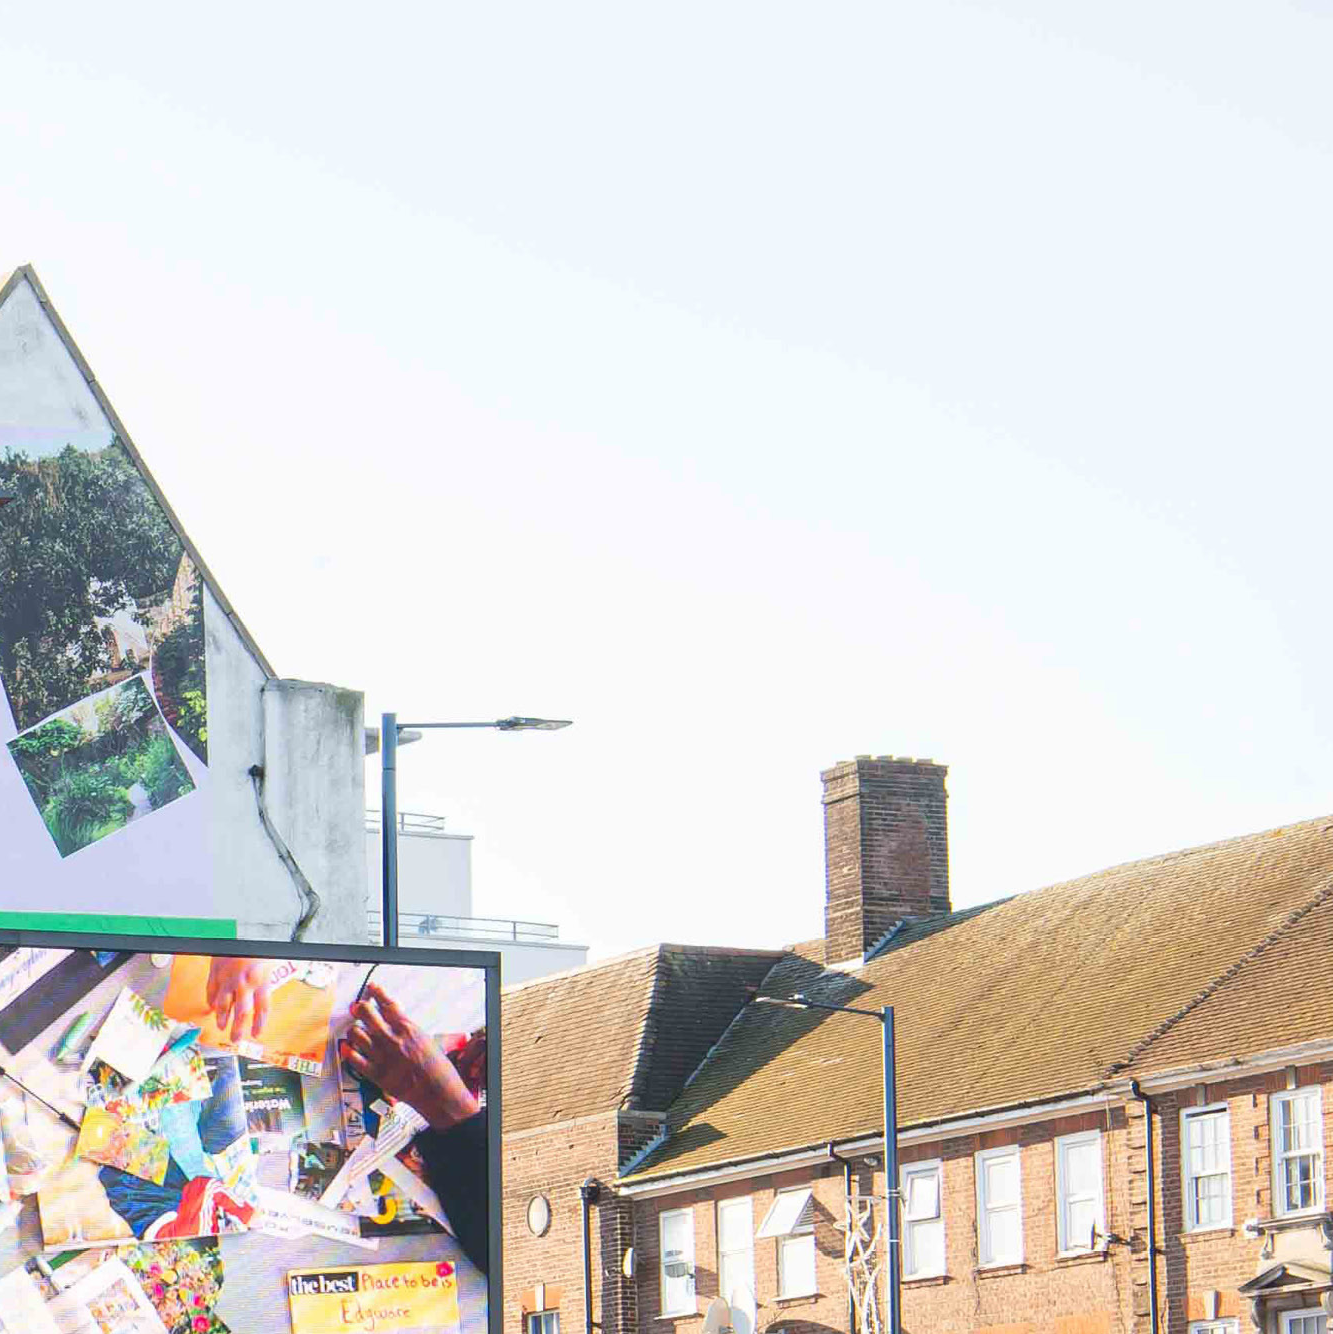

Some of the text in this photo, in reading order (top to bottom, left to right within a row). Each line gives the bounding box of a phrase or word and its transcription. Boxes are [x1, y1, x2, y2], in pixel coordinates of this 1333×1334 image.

[291, 1275, 318, 1296] the
[318, 1274, 356, 1293] best
[361, 1273, 399, 1290] Place
[341, 1298, 411, 1332] Edgware
